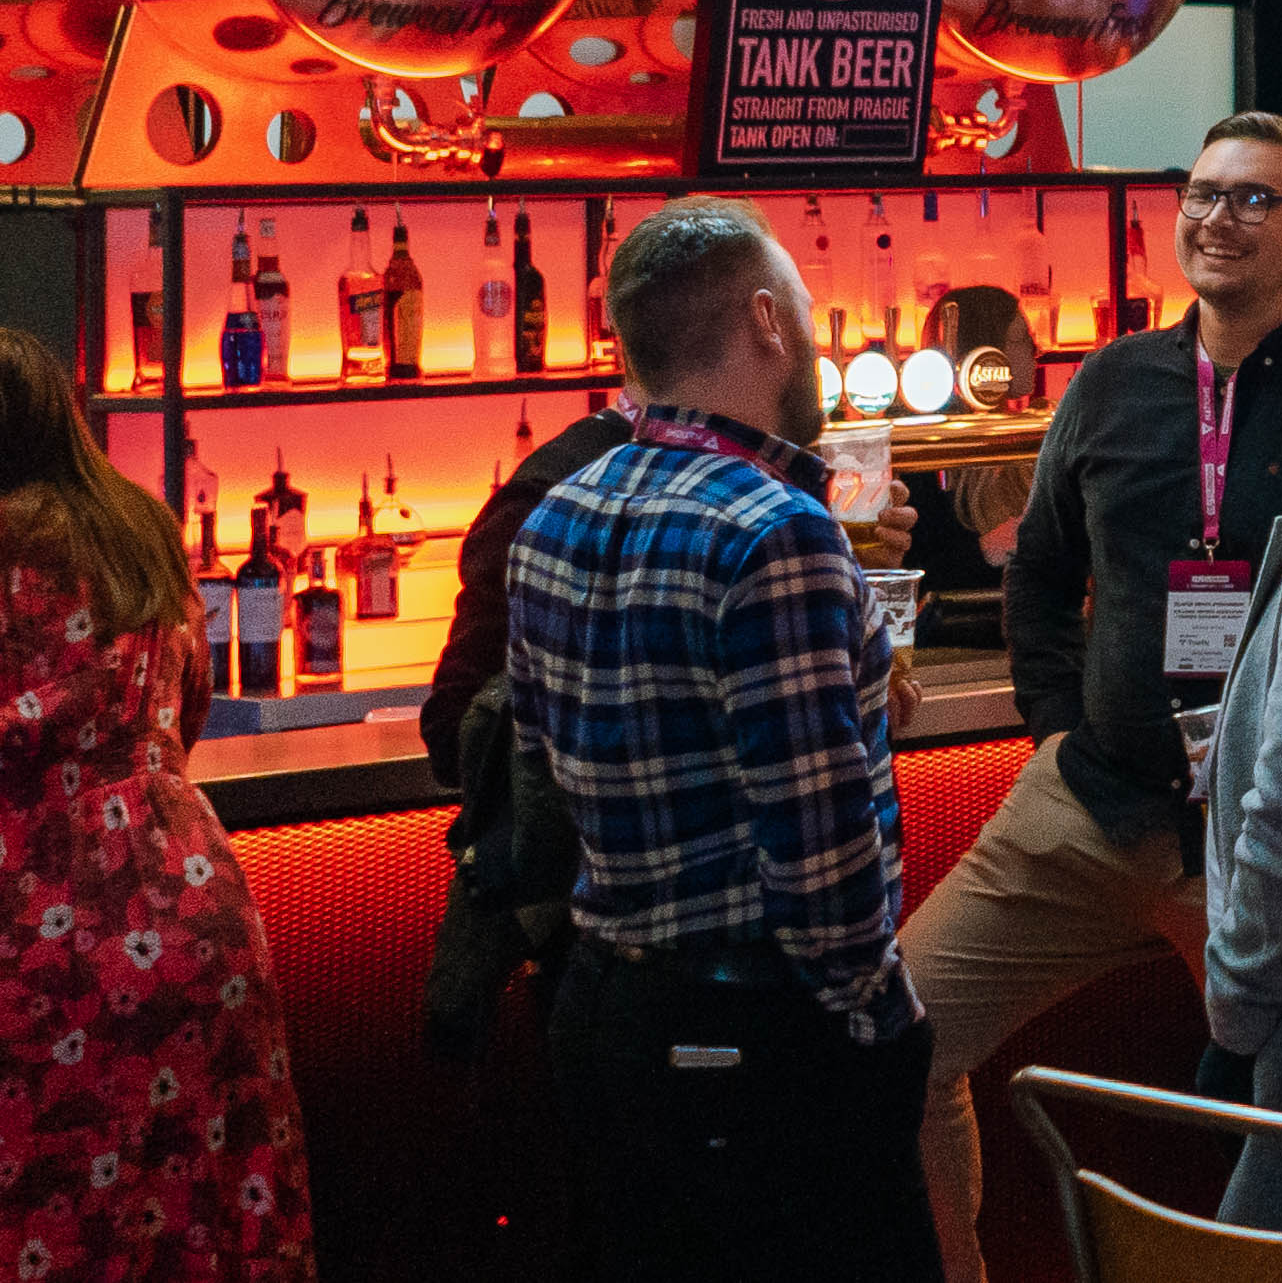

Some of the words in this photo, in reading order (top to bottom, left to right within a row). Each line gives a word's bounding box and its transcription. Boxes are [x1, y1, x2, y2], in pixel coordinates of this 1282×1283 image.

[741, 8, 784, 30] FRESH
[786, 9, 814, 31] AND
[817, 10, 919, 32] UNPASTEURISED
[738, 37, 823, 87] TANK
[831, 38, 915, 88] BEER
[732, 96, 804, 120] STRAIGHT
[807, 97, 849, 120] FROM
[853, 97, 911, 120] PRAGUE
[730, 125, 768, 148] TANK
[771, 125, 812, 148] OPEN
